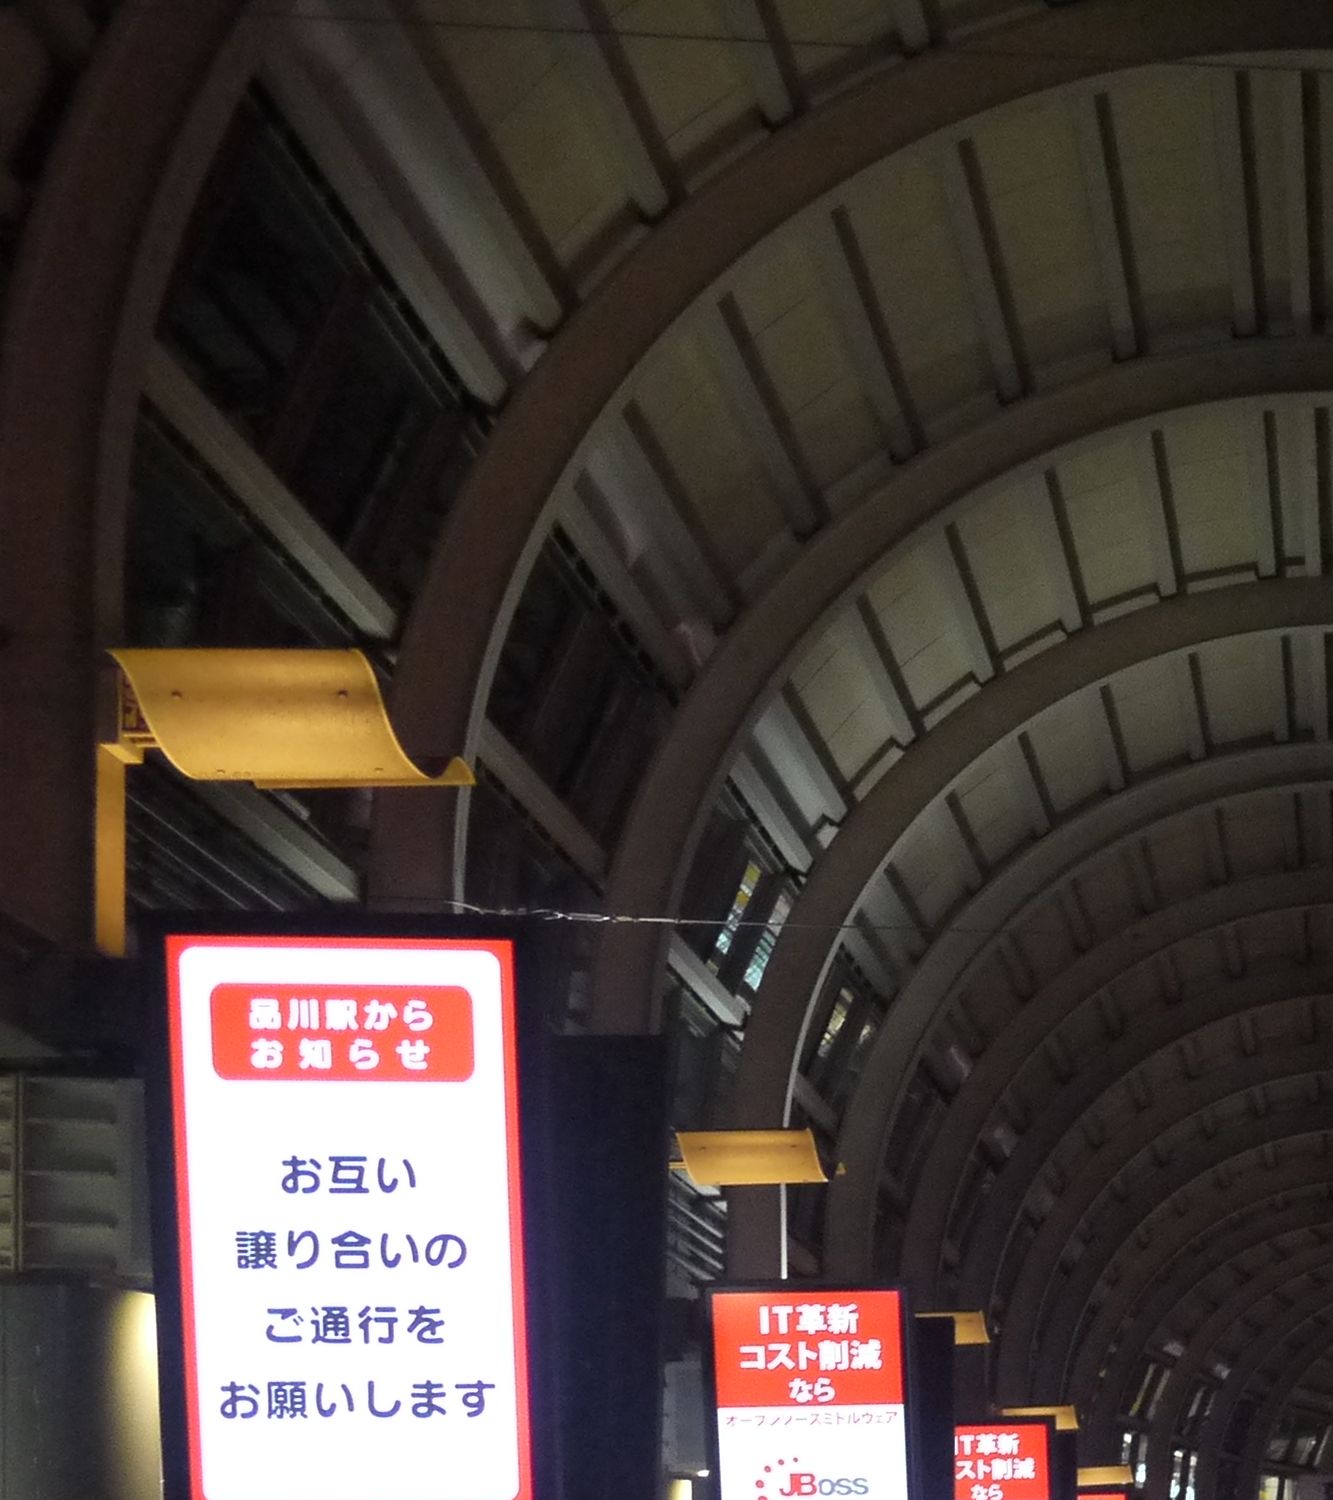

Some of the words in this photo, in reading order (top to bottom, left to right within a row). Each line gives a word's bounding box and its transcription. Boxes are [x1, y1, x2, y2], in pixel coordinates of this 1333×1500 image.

[249, 998, 434, 1031] 品川駅から
[250, 1038, 430, 1070] お知らせ
[281, 1155, 416, 1194] お互い
[235, 1230, 467, 1269] 譲り合いの
[265, 1306, 445, 1344] ご通行を
[758, 1303, 859, 1335] IT革新
[739, 1338, 883, 1370] コスト削減
[219, 1380, 496, 1418] お願いします
[789, 1377, 836, 1403] なら
[779, 1472, 869, 1496] JBoss
[955, 1458, 1035, 1480] スト削減
